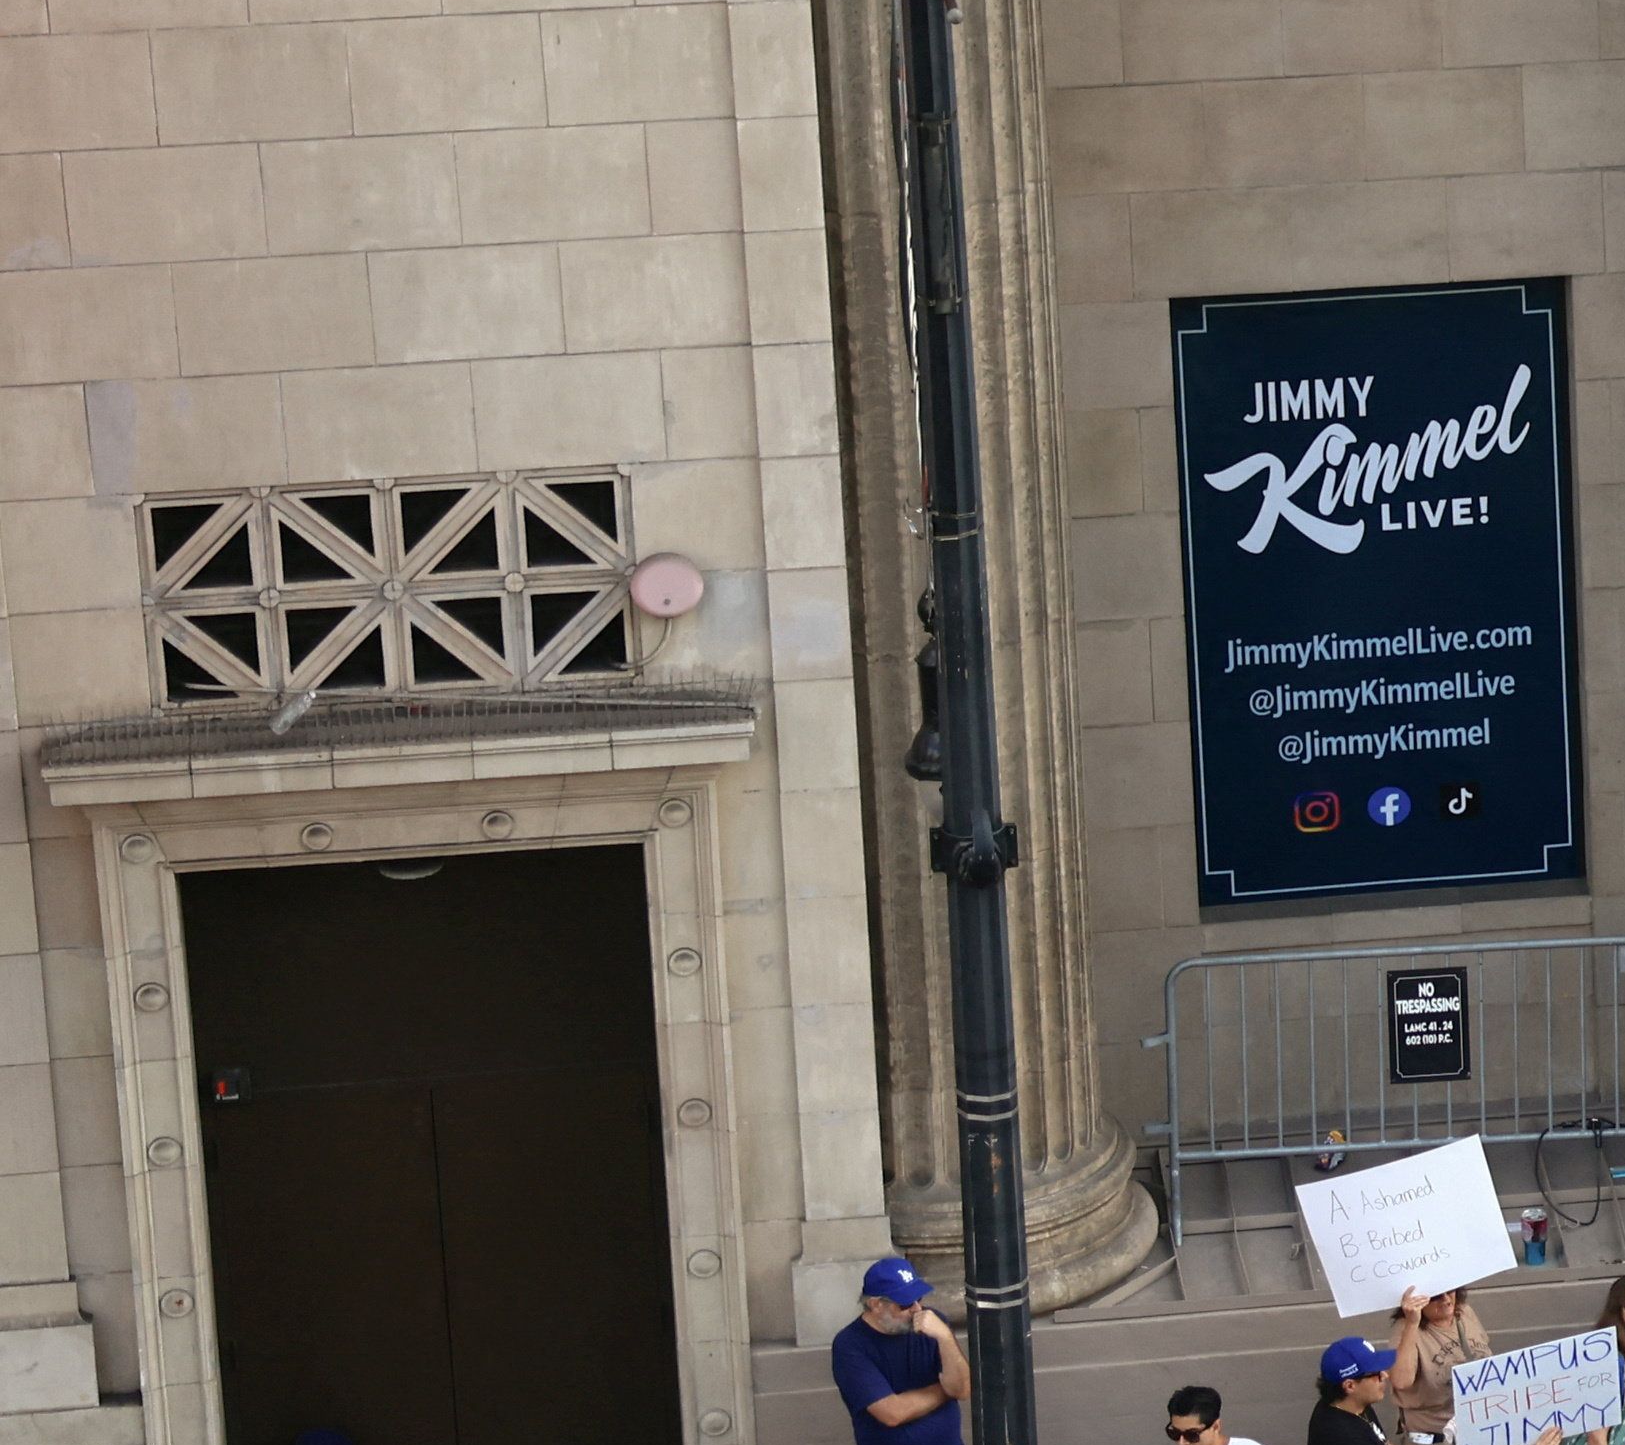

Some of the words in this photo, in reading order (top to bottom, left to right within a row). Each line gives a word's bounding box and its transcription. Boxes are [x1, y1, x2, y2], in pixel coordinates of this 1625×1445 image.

[1243, 376, 1375, 424] JIMMY
[1203, 364, 1531, 554] Kimmel
[1381, 496, 1489, 531] LIVE!
[1225, 625, 1532, 673] JimmyKimmelLive.com
[1249, 669, 1515, 718] @JimmyKimmelLive
[1278, 718, 1491, 764] @JimmyKimmel
[1360, 1175, 1435, 1215] Ashamed
[1367, 1220, 1424, 1251] Bribed
[1373, 1246, 1451, 1278] Cowards
[1454, 1331, 1612, 1395] WAMPUS
[1461, 1376, 1572, 1424] TRIBE
[1578, 1373, 1615, 1390] FOR
